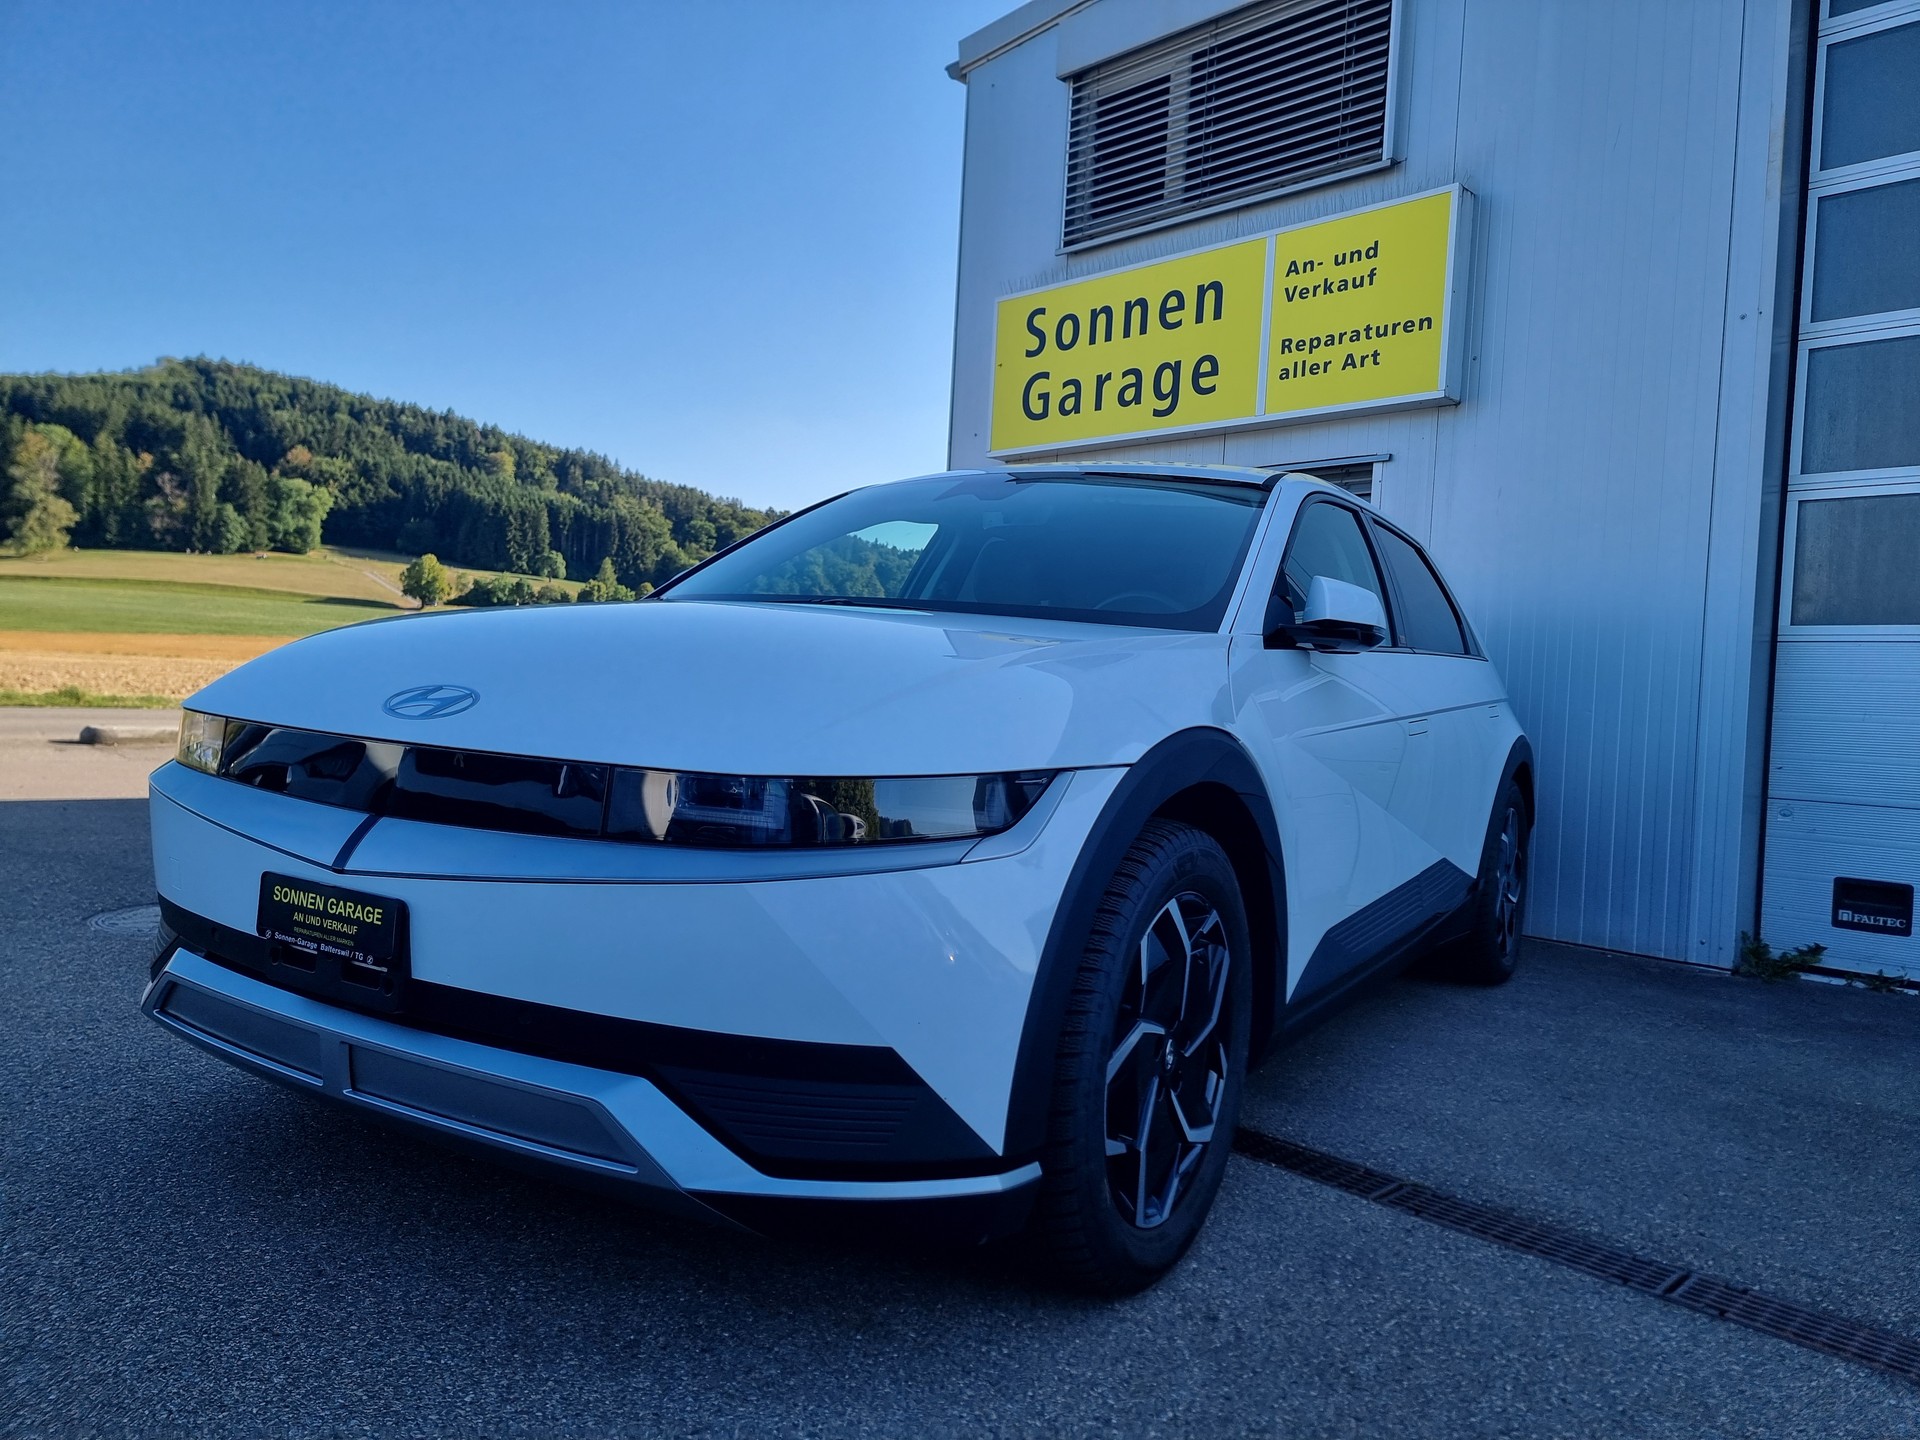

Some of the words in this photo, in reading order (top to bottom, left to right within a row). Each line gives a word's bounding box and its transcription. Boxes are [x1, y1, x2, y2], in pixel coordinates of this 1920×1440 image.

[1285, 260, 1324, 278] An-
[1333, 240, 1379, 266] und
[1284, 267, 1378, 303] Verkauf
[1025, 280, 1224, 358] Sonnen
[1280, 315, 1433, 355] Reparaturen
[1278, 360, 1332, 381] aller
[1341, 349, 1381, 371] Art
[1022, 353, 1220, 421] Garage
[273, 885, 325, 912] SONNEN
[327, 898, 383, 925] GARAGE
[293, 911, 304, 922] AN
[305, 914, 321, 926] UND
[322, 918, 358, 935] VERKAUF
[1853, 913, 1906, 928] FALTEC
[354, 951, 364, 961] TG
